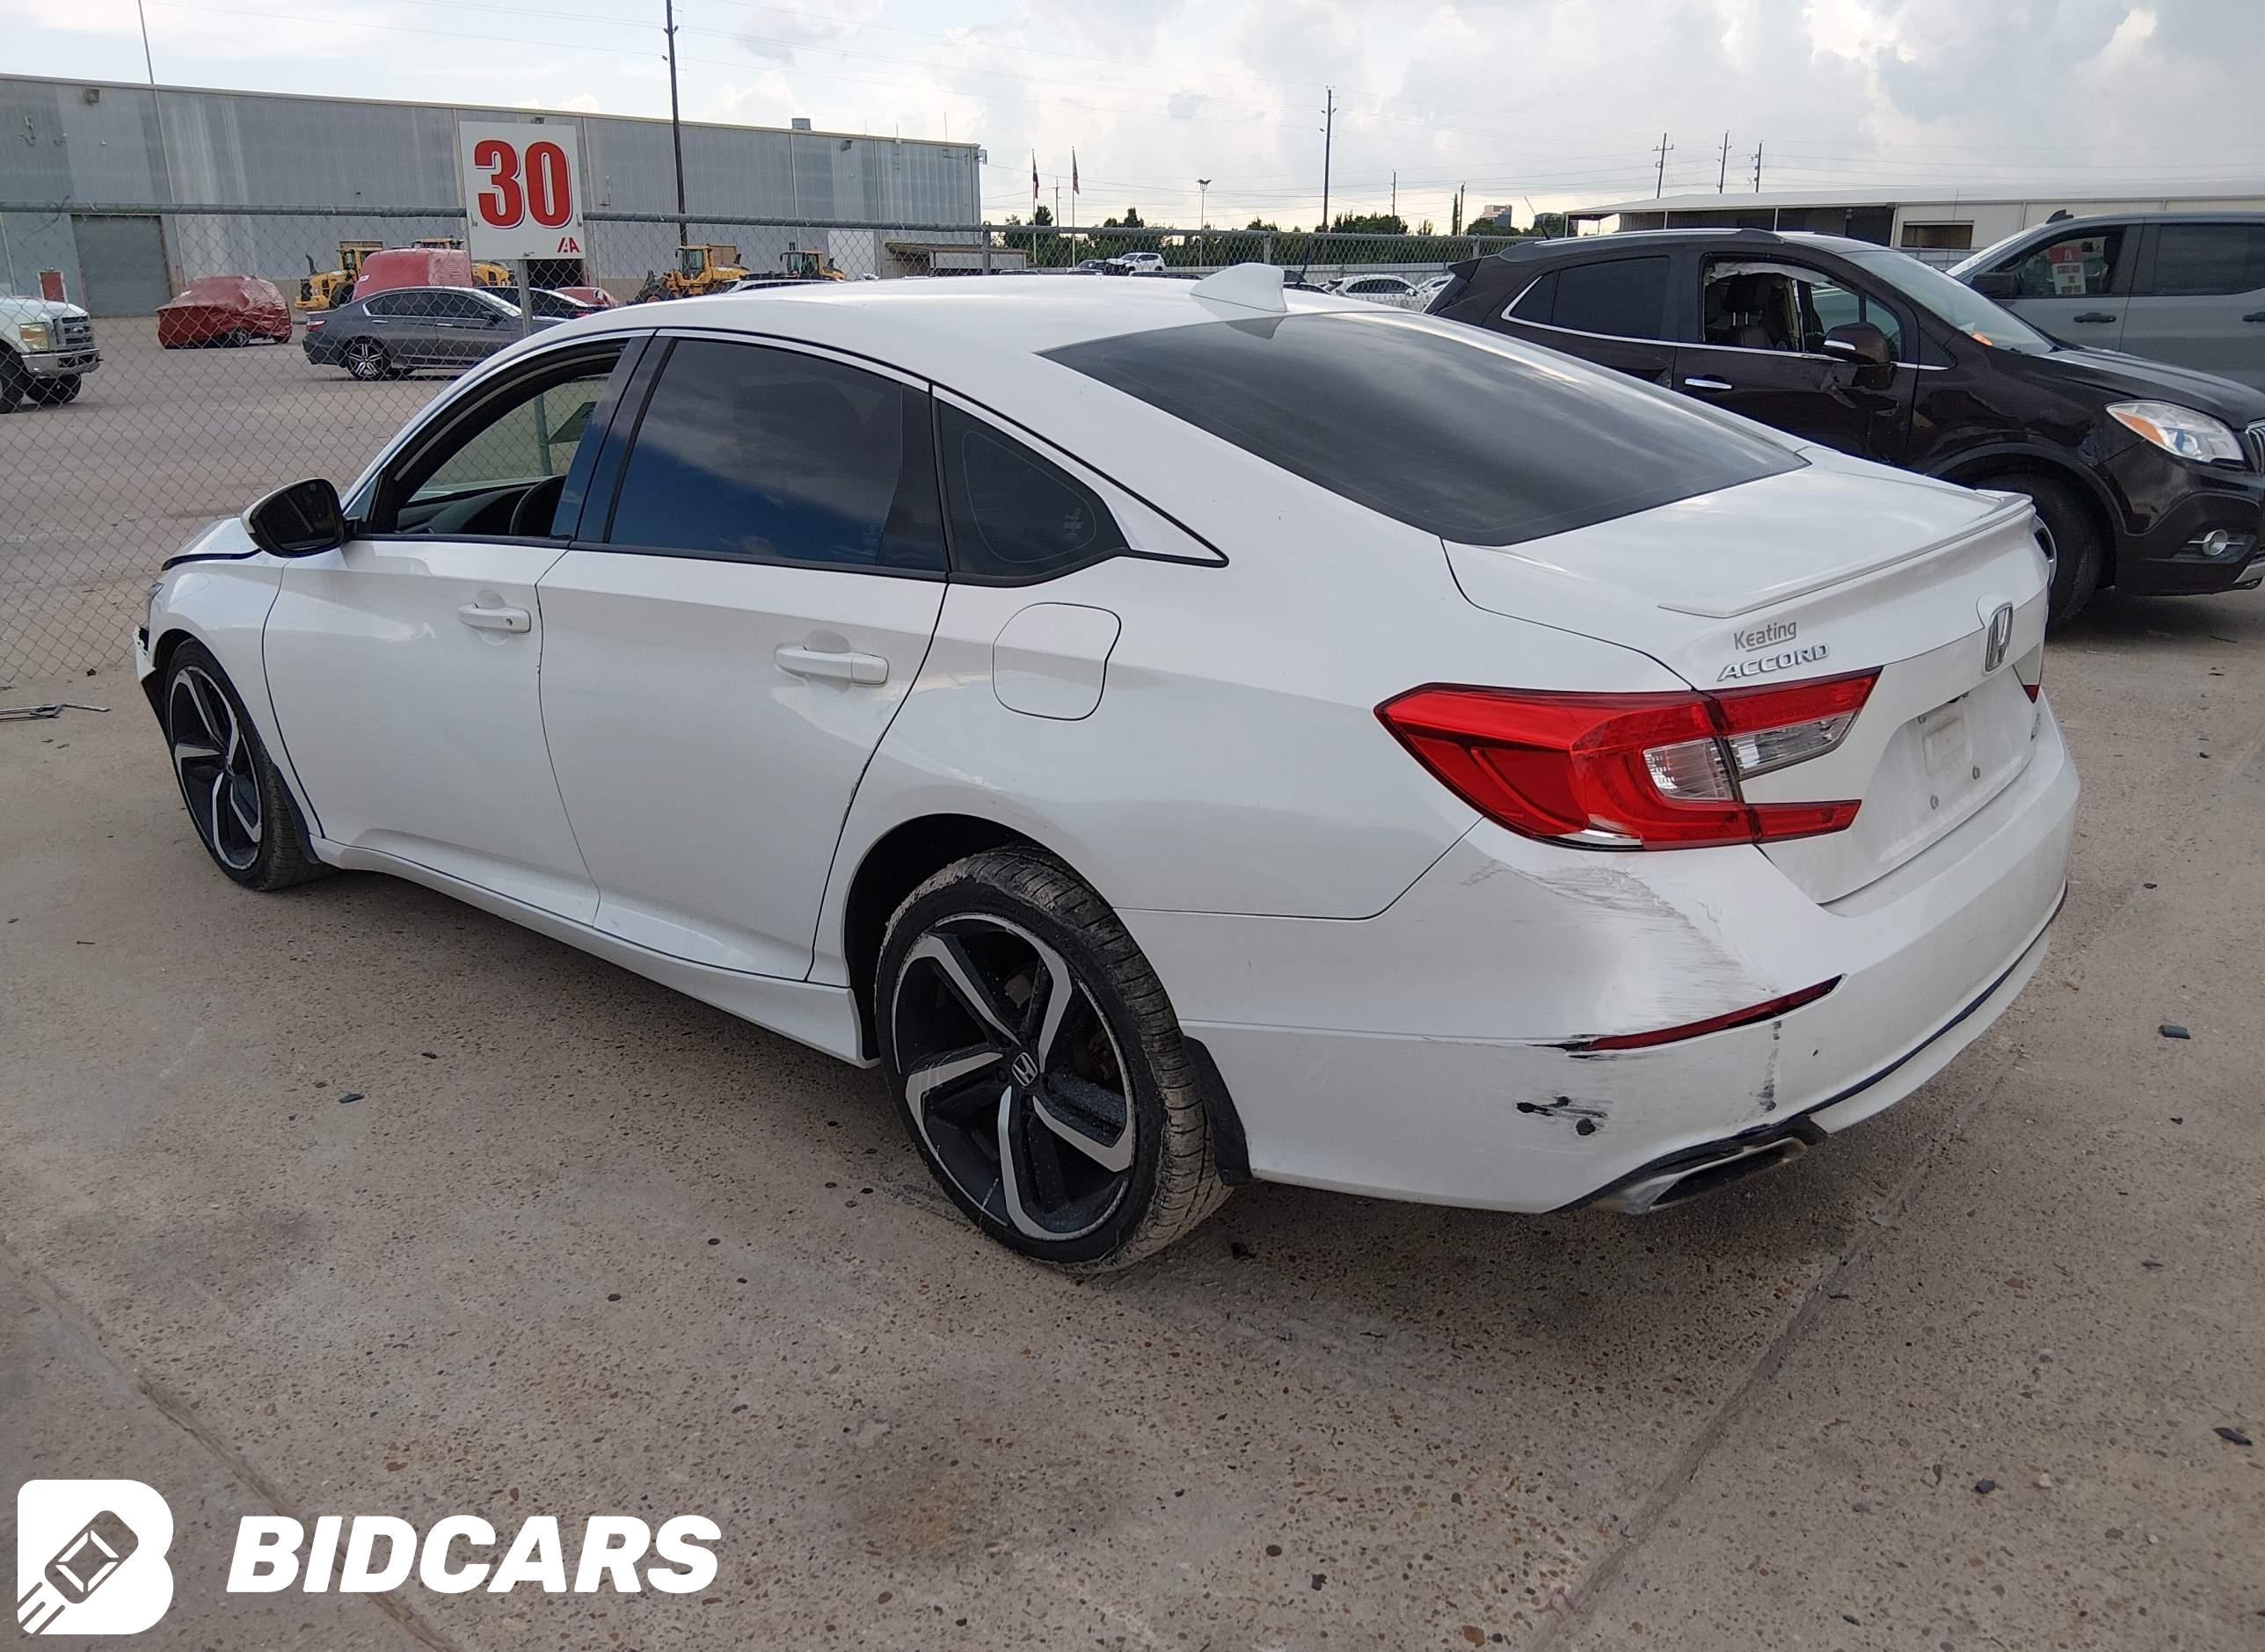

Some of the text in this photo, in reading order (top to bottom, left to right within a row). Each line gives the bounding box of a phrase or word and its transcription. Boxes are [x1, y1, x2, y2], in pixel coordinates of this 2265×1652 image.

[473, 139, 573, 229] 30
[1733, 621, 1797, 652] Keating
[1716, 644, 1829, 682] ACCORD
